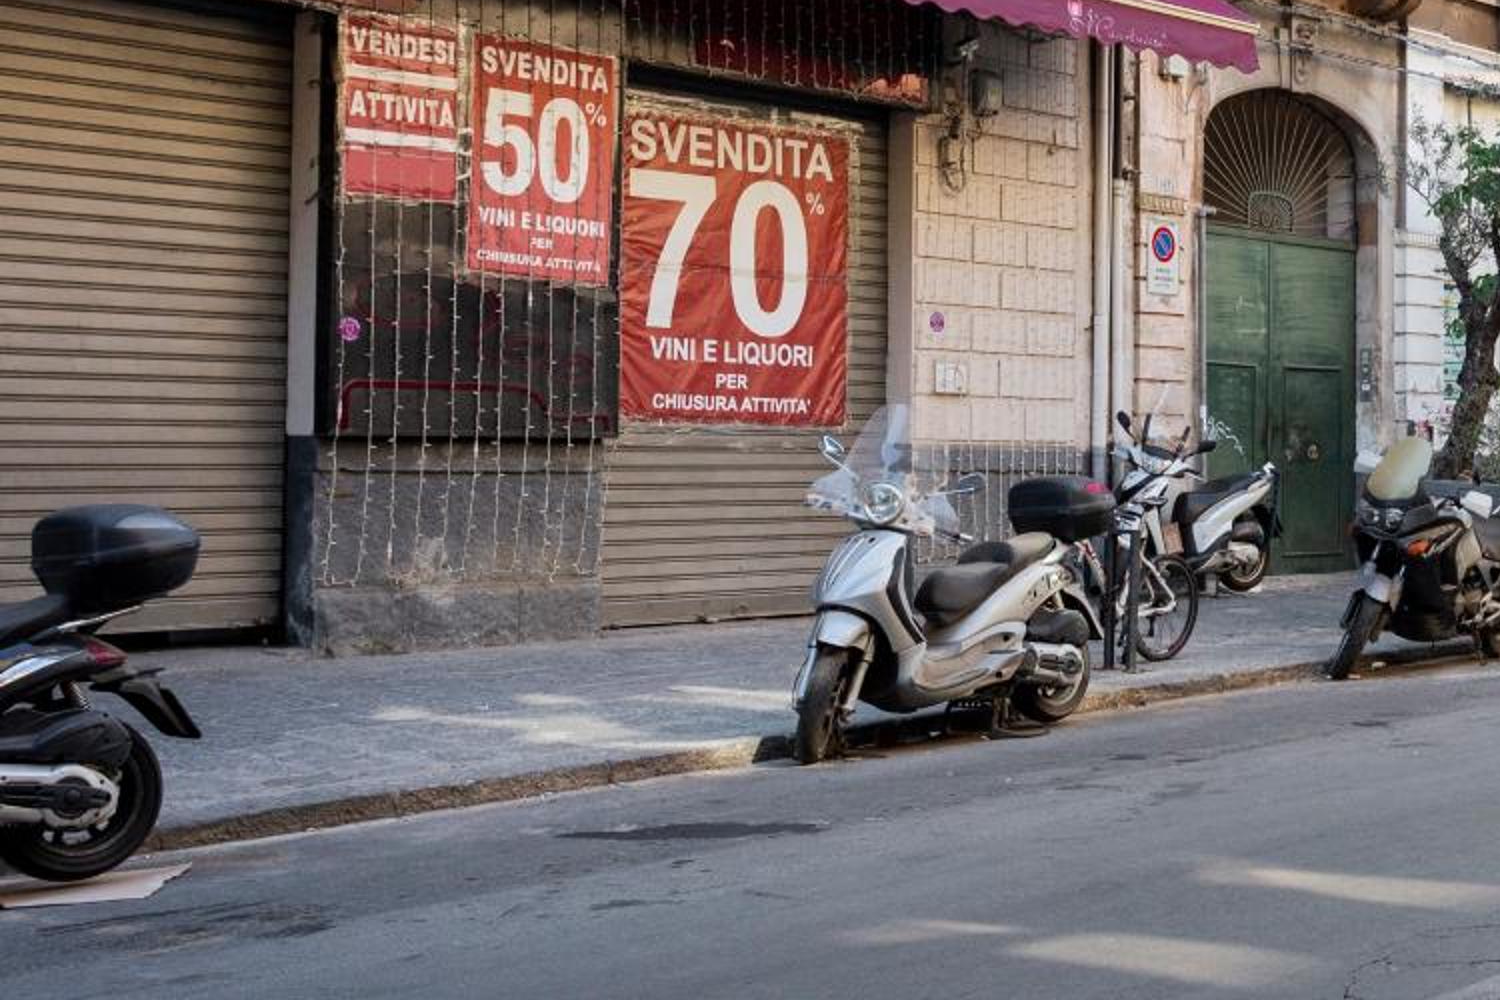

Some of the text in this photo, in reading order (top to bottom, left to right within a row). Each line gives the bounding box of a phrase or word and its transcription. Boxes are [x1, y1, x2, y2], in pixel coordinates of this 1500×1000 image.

[351, 26, 456, 66] VENDESI
[481, 46, 608, 94] SVENDITA
[630, 119, 834, 182] SVENDITA
[478, 205, 605, 238] VINI E LIQUORI
[650, 335, 813, 368] VINI E LIQUORI
[715, 373, 748, 390] PER
[652, 393, 736, 411] CHIUSURA
